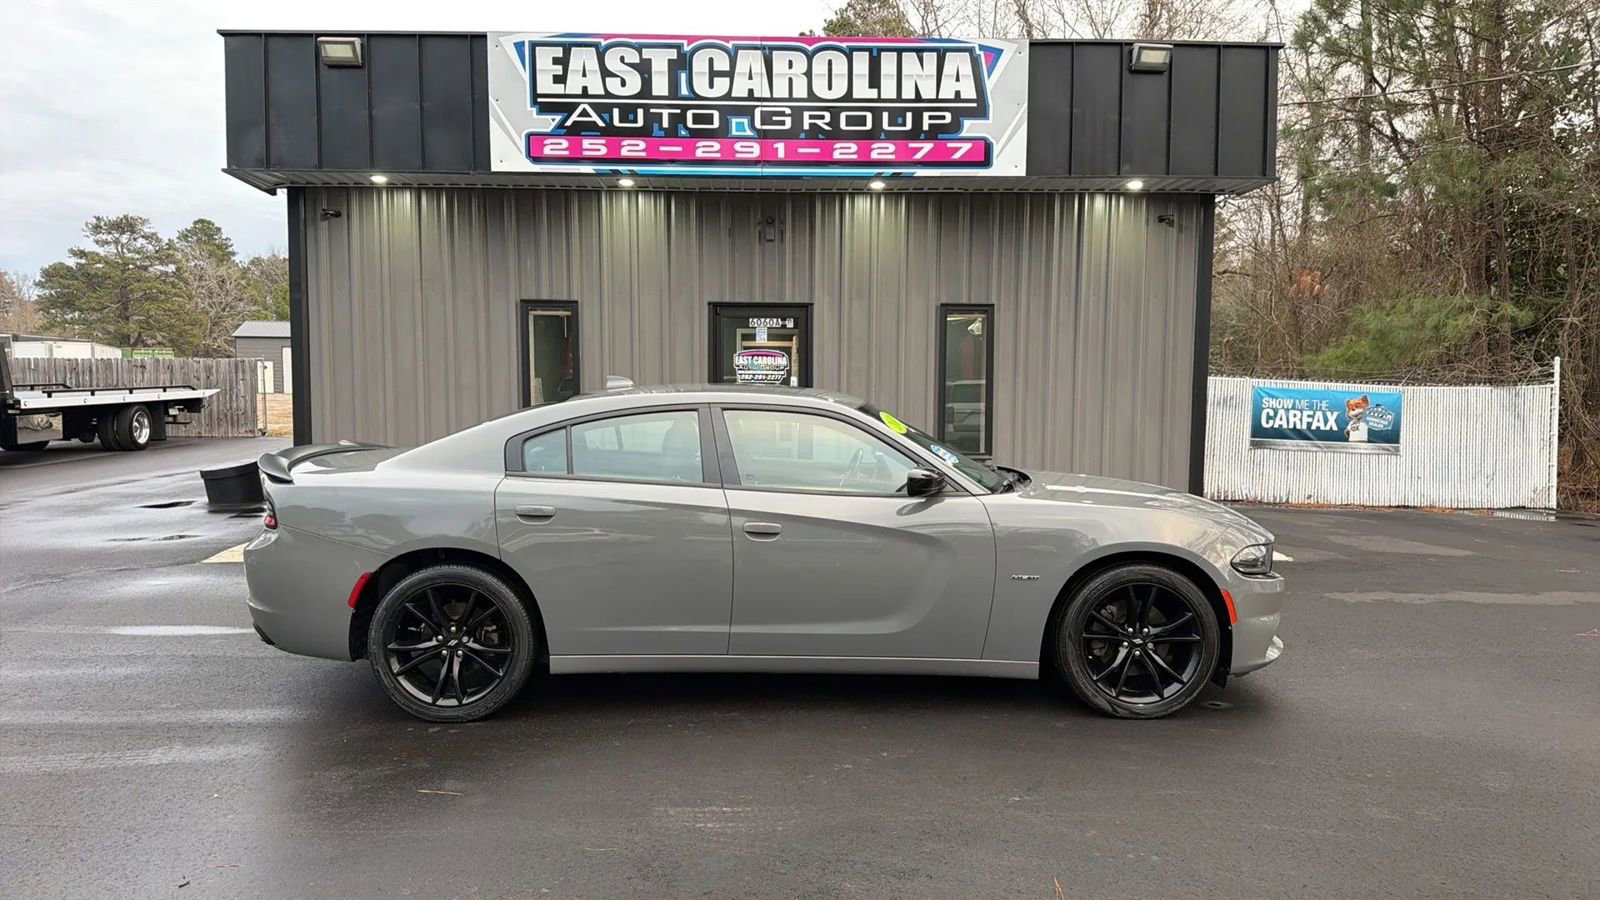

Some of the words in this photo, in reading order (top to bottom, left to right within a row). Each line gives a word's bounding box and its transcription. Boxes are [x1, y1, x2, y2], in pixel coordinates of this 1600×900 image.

[535, 47, 677, 96] EAST
[692, 51, 978, 100] CAROLINA
[564, 104, 720, 130] AUTO
[754, 106, 953, 131] GROUP
[543, 139, 974, 160] 252-291-2277
[735, 355, 753, 365] EAST
[753, 355, 787, 365] CAROLINA
[1261, 397, 1294, 409] SHOW
[1294, 399, 1311, 410] ME
[1312, 400, 1330, 411] THE
[1260, 408, 1341, 431] CARFAX
